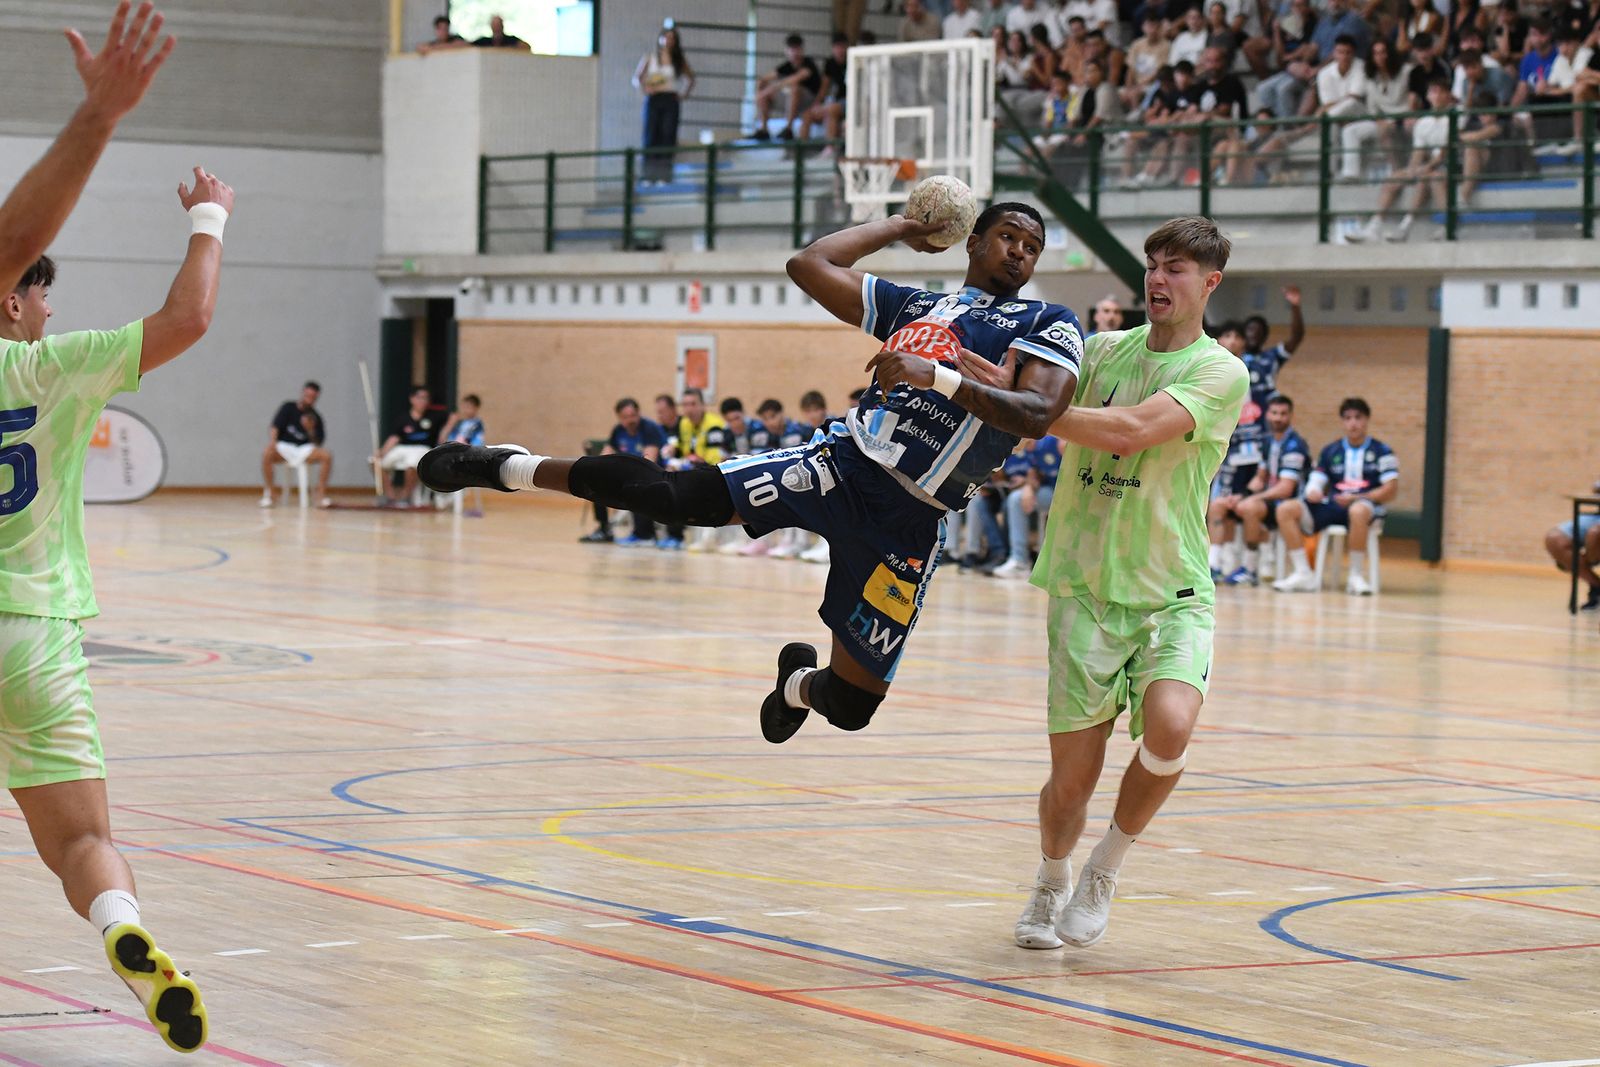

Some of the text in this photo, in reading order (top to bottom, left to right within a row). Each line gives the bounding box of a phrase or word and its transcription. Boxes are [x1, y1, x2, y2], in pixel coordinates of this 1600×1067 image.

[743, 472, 779, 507] 10
[845, 620, 885, 662] INGENIEROS
[849, 602, 903, 655] HW
